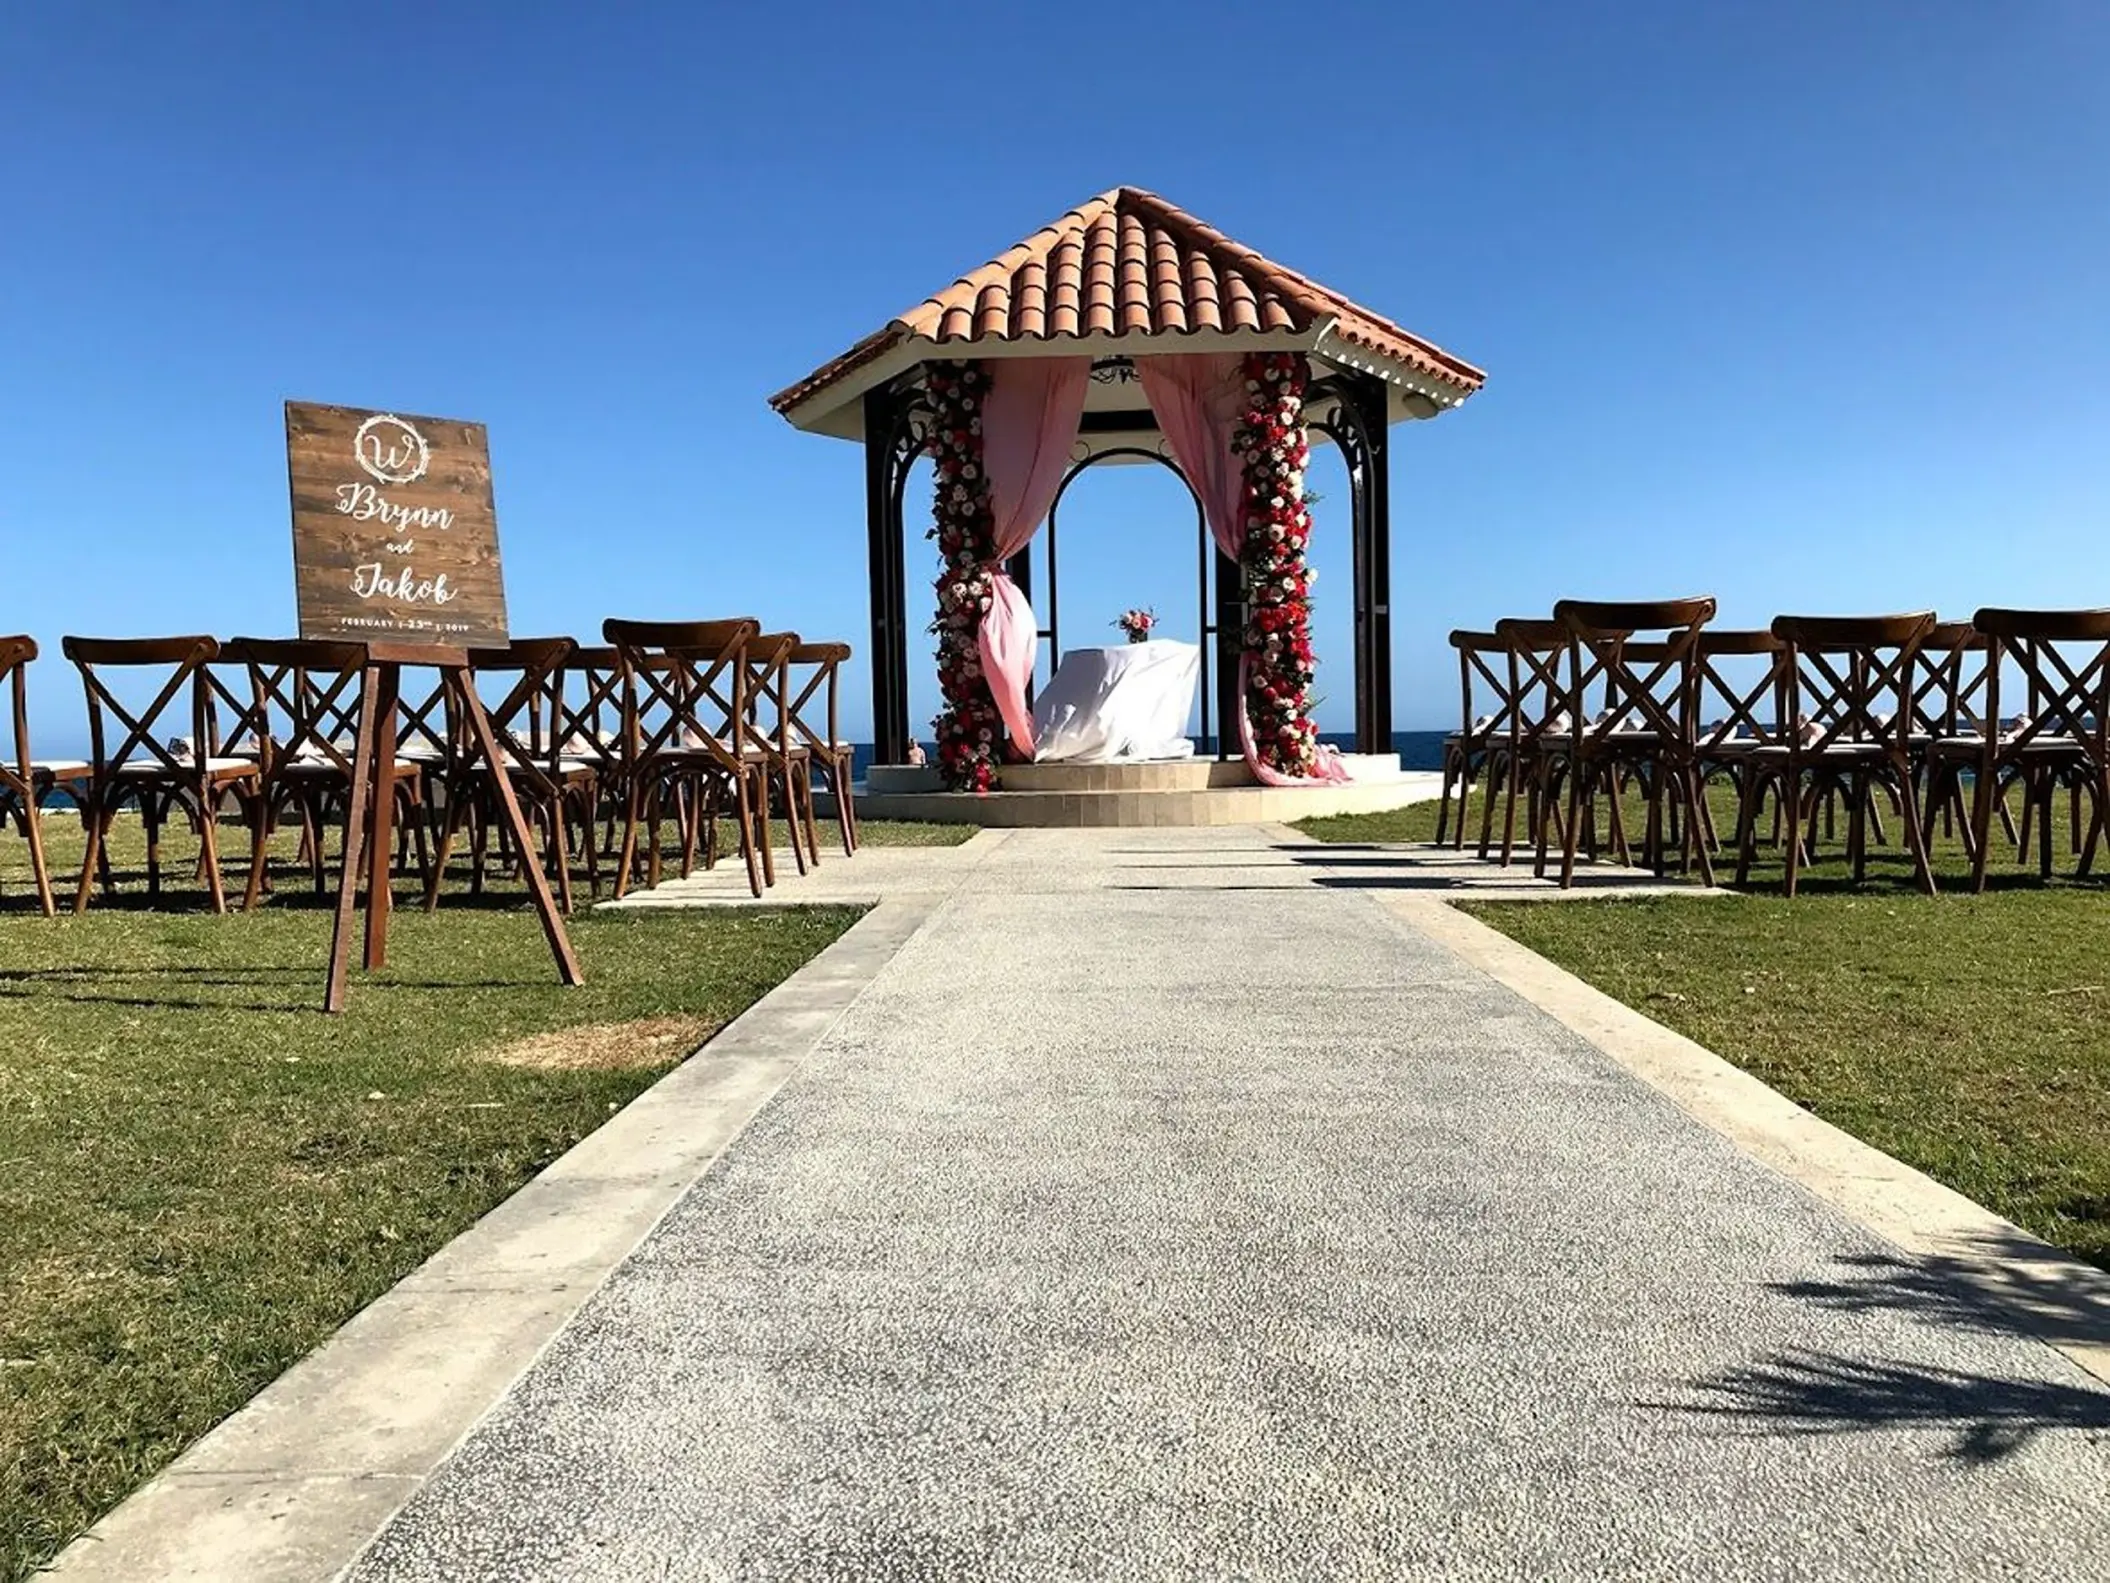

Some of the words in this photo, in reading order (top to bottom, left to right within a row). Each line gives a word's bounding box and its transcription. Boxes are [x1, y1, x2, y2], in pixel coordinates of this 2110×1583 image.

[364, 434, 415, 469] W
[335, 482, 455, 532] Brynn
[387, 539, 414, 554] and
[350, 562, 457, 604] Jakob
[341, 617, 393, 627] FEBRUARY
